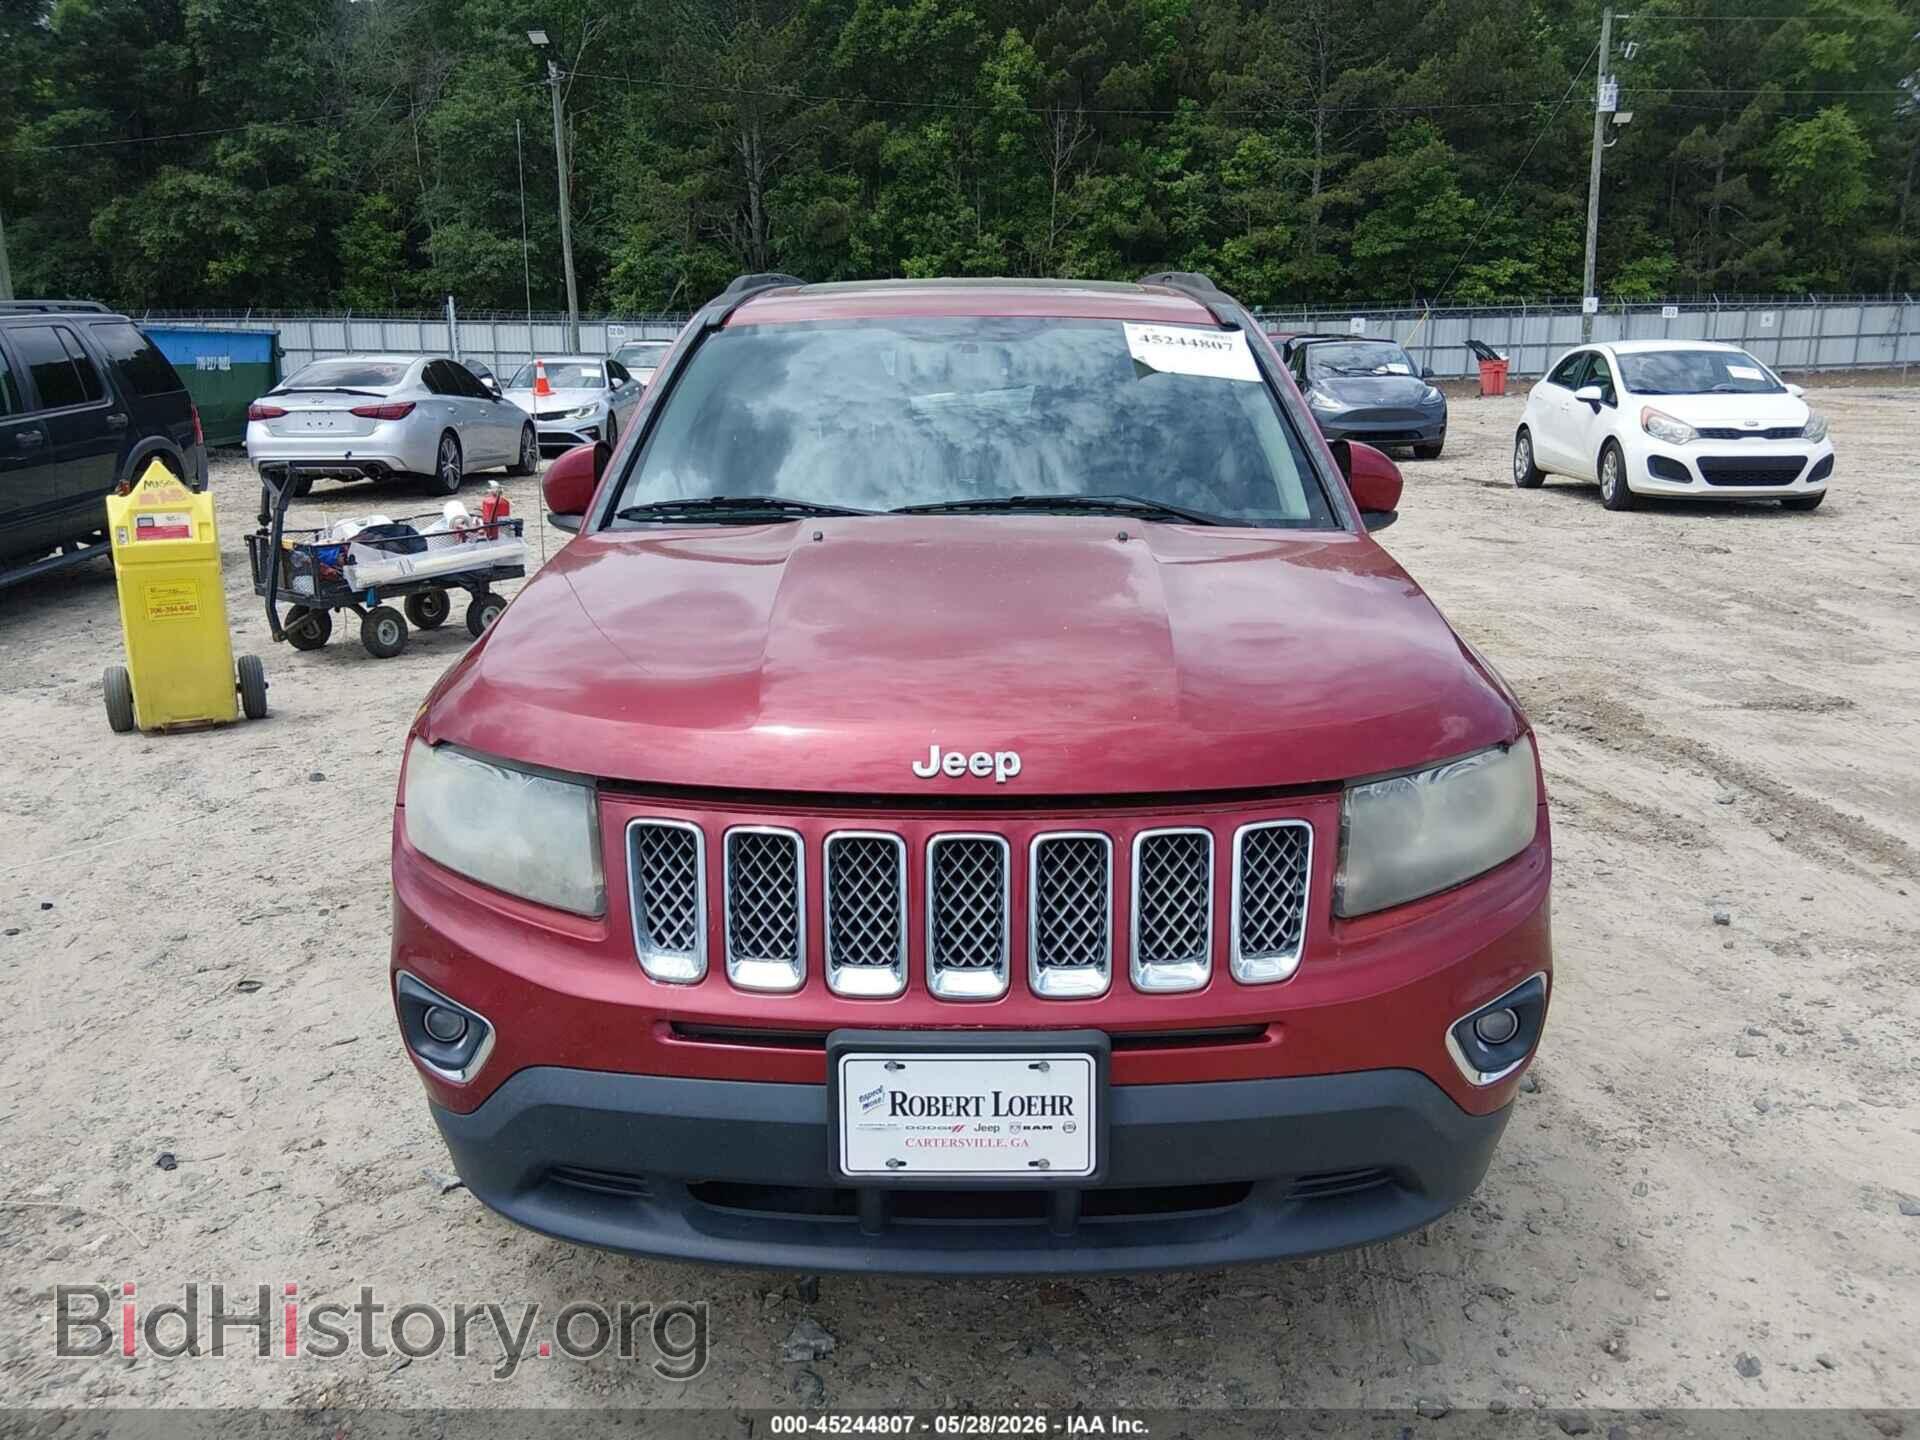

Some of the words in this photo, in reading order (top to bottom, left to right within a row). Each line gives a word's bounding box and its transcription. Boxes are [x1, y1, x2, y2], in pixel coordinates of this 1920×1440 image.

[1138, 334, 1233, 351] 45244807
[912, 745, 1021, 783] Jeep
[888, 1091, 985, 1117] ROBERT
[992, 1091, 1074, 1117] LOEHR
[974, 1123, 1000, 1133] Jeep
[1011, 1138, 1029, 1148] GA
